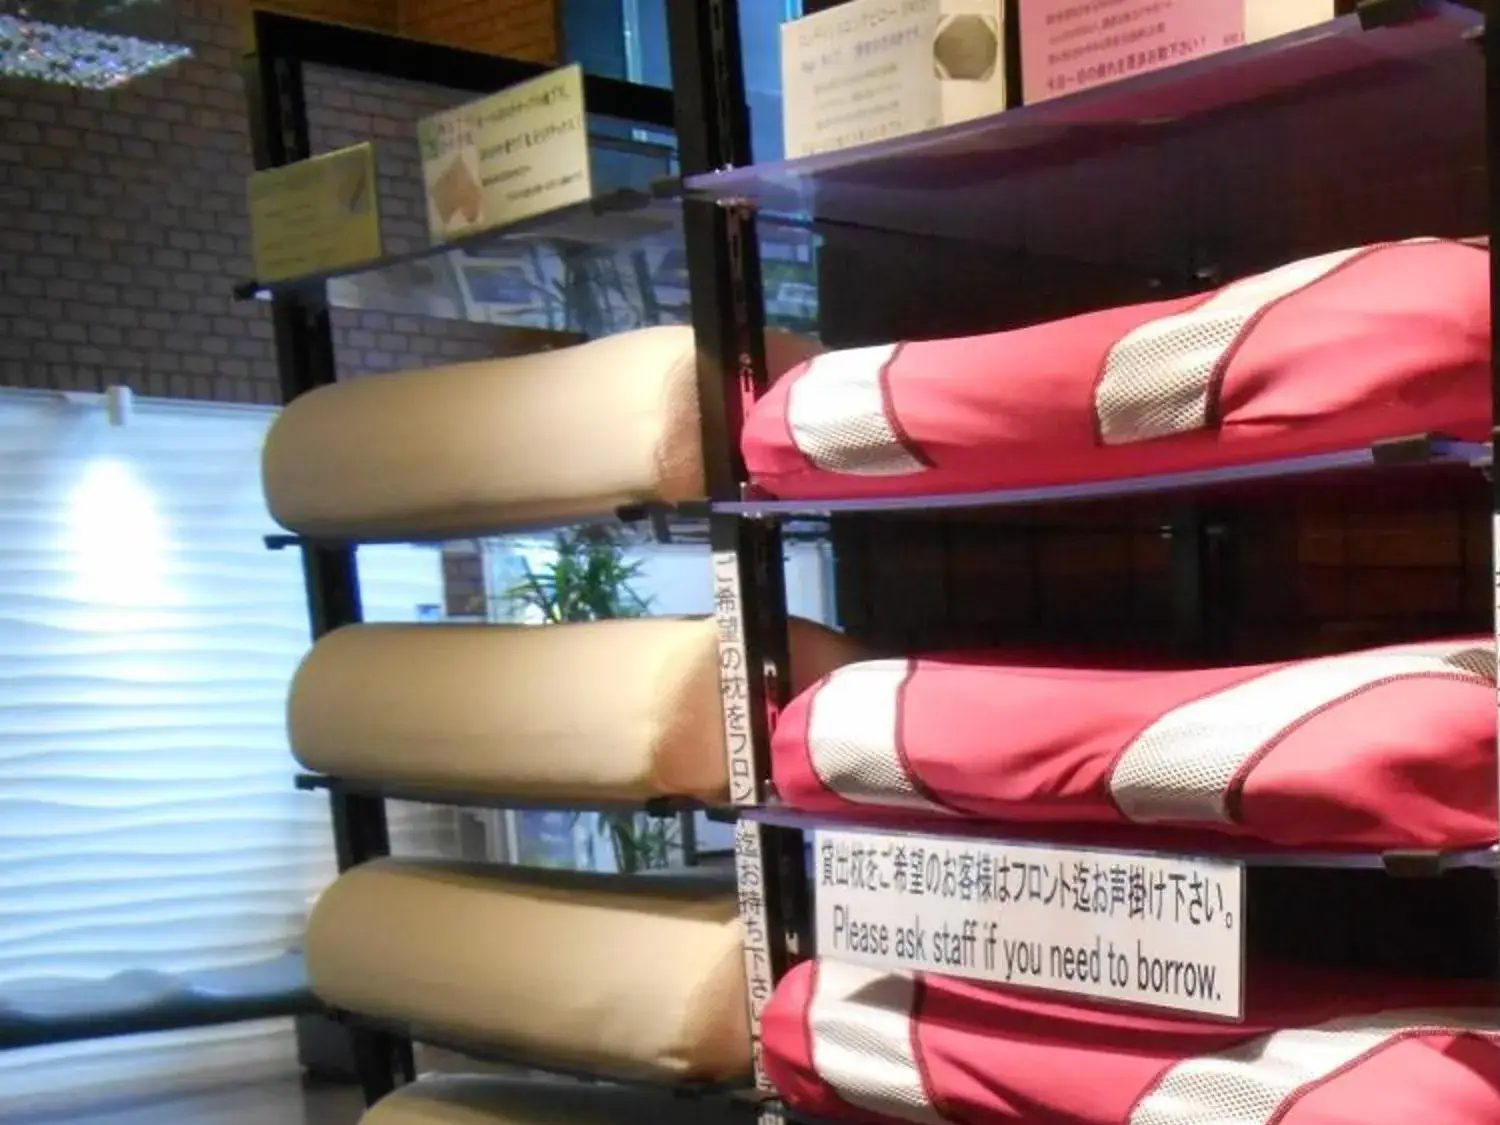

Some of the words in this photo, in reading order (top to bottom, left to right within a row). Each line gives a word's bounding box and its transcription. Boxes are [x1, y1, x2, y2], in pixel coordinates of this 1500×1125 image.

[833, 905, 889, 956] Please
[895, 914, 926, 962] ask
[932, 920, 977, 968] staff
[983, 922, 999, 974] if
[1004, 939, 1042, 981] you
[1050, 935, 1101, 984] need
[1107, 941, 1129, 988] to
[1137, 939, 1222, 1001] borrow.
